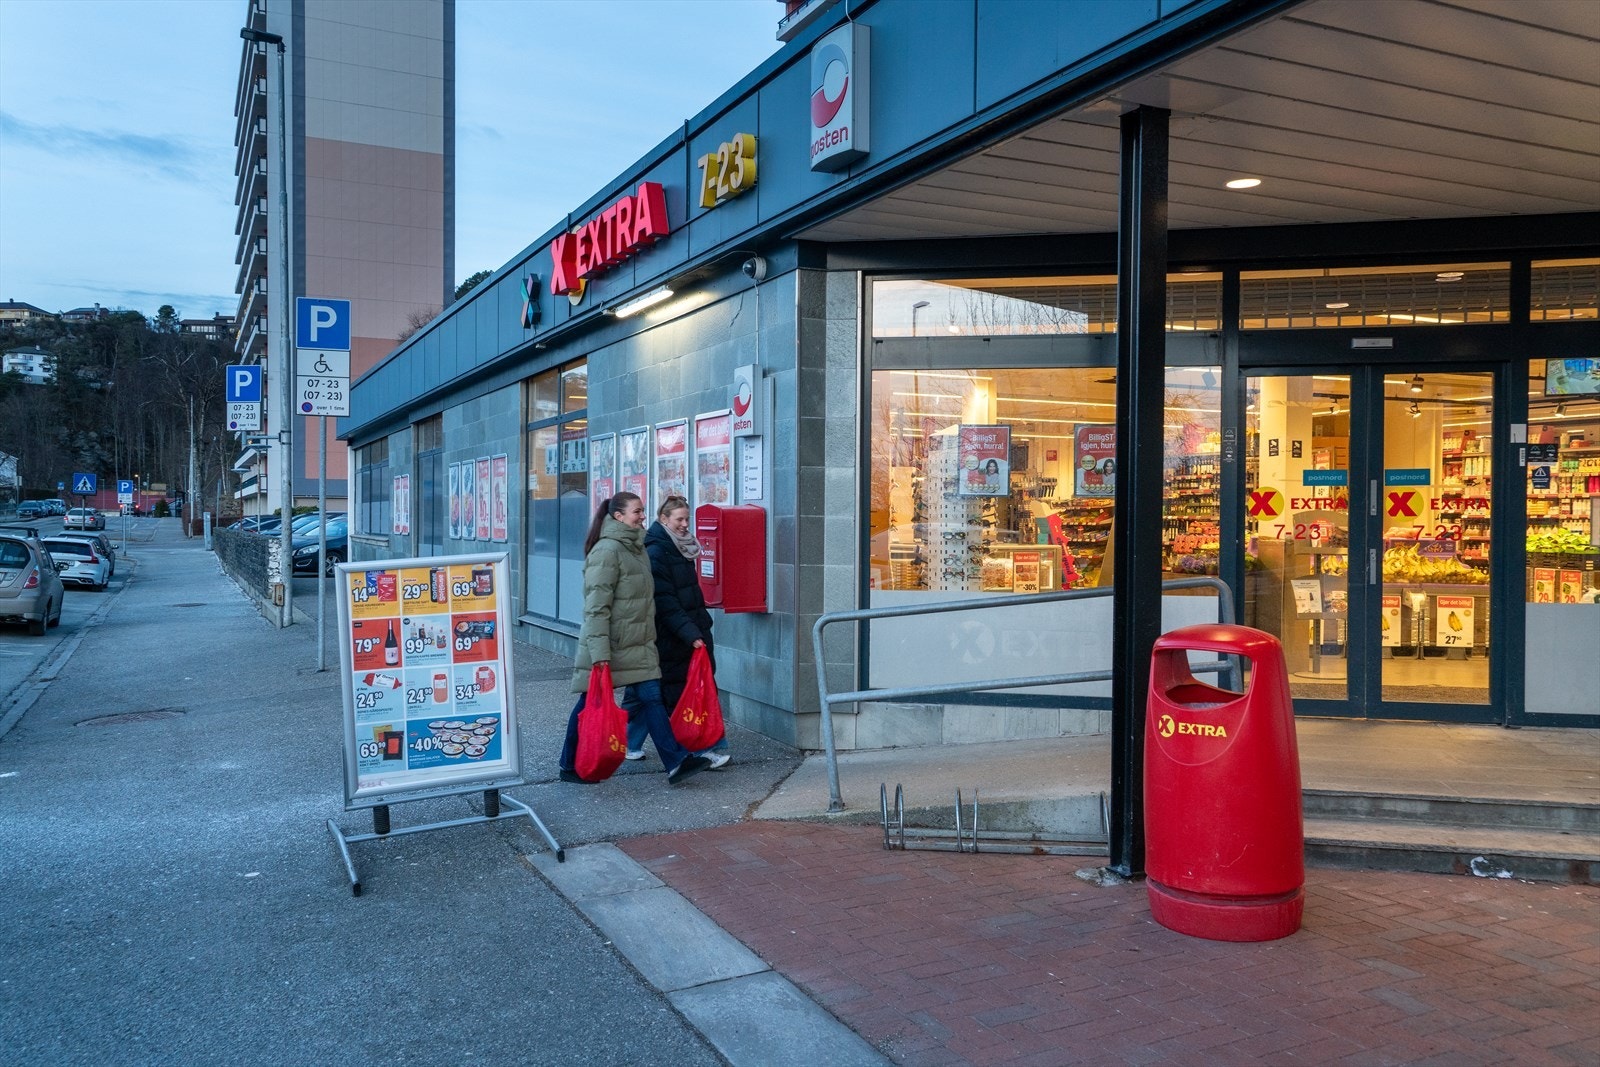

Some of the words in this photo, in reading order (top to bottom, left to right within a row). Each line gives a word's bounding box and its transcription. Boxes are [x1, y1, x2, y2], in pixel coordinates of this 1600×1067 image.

[697, 132, 752, 208] 7-23
[576, 181, 664, 279] EXTRA
[310, 305, 338, 342] P
[235, 370, 253, 397] P
[1088, 433, 1114, 442] BilligST
[1081, 442, 1100, 450] igjen,
[121, 482, 130, 492] P
[1290, 497, 1348, 510] EXTRA
[1430, 498, 1490, 510] EXTRA
[1023, 583, 1037, 591] -30%
[1178, 722, 1228, 738] EXTRA
[409, 736, 443, 751] -40%
